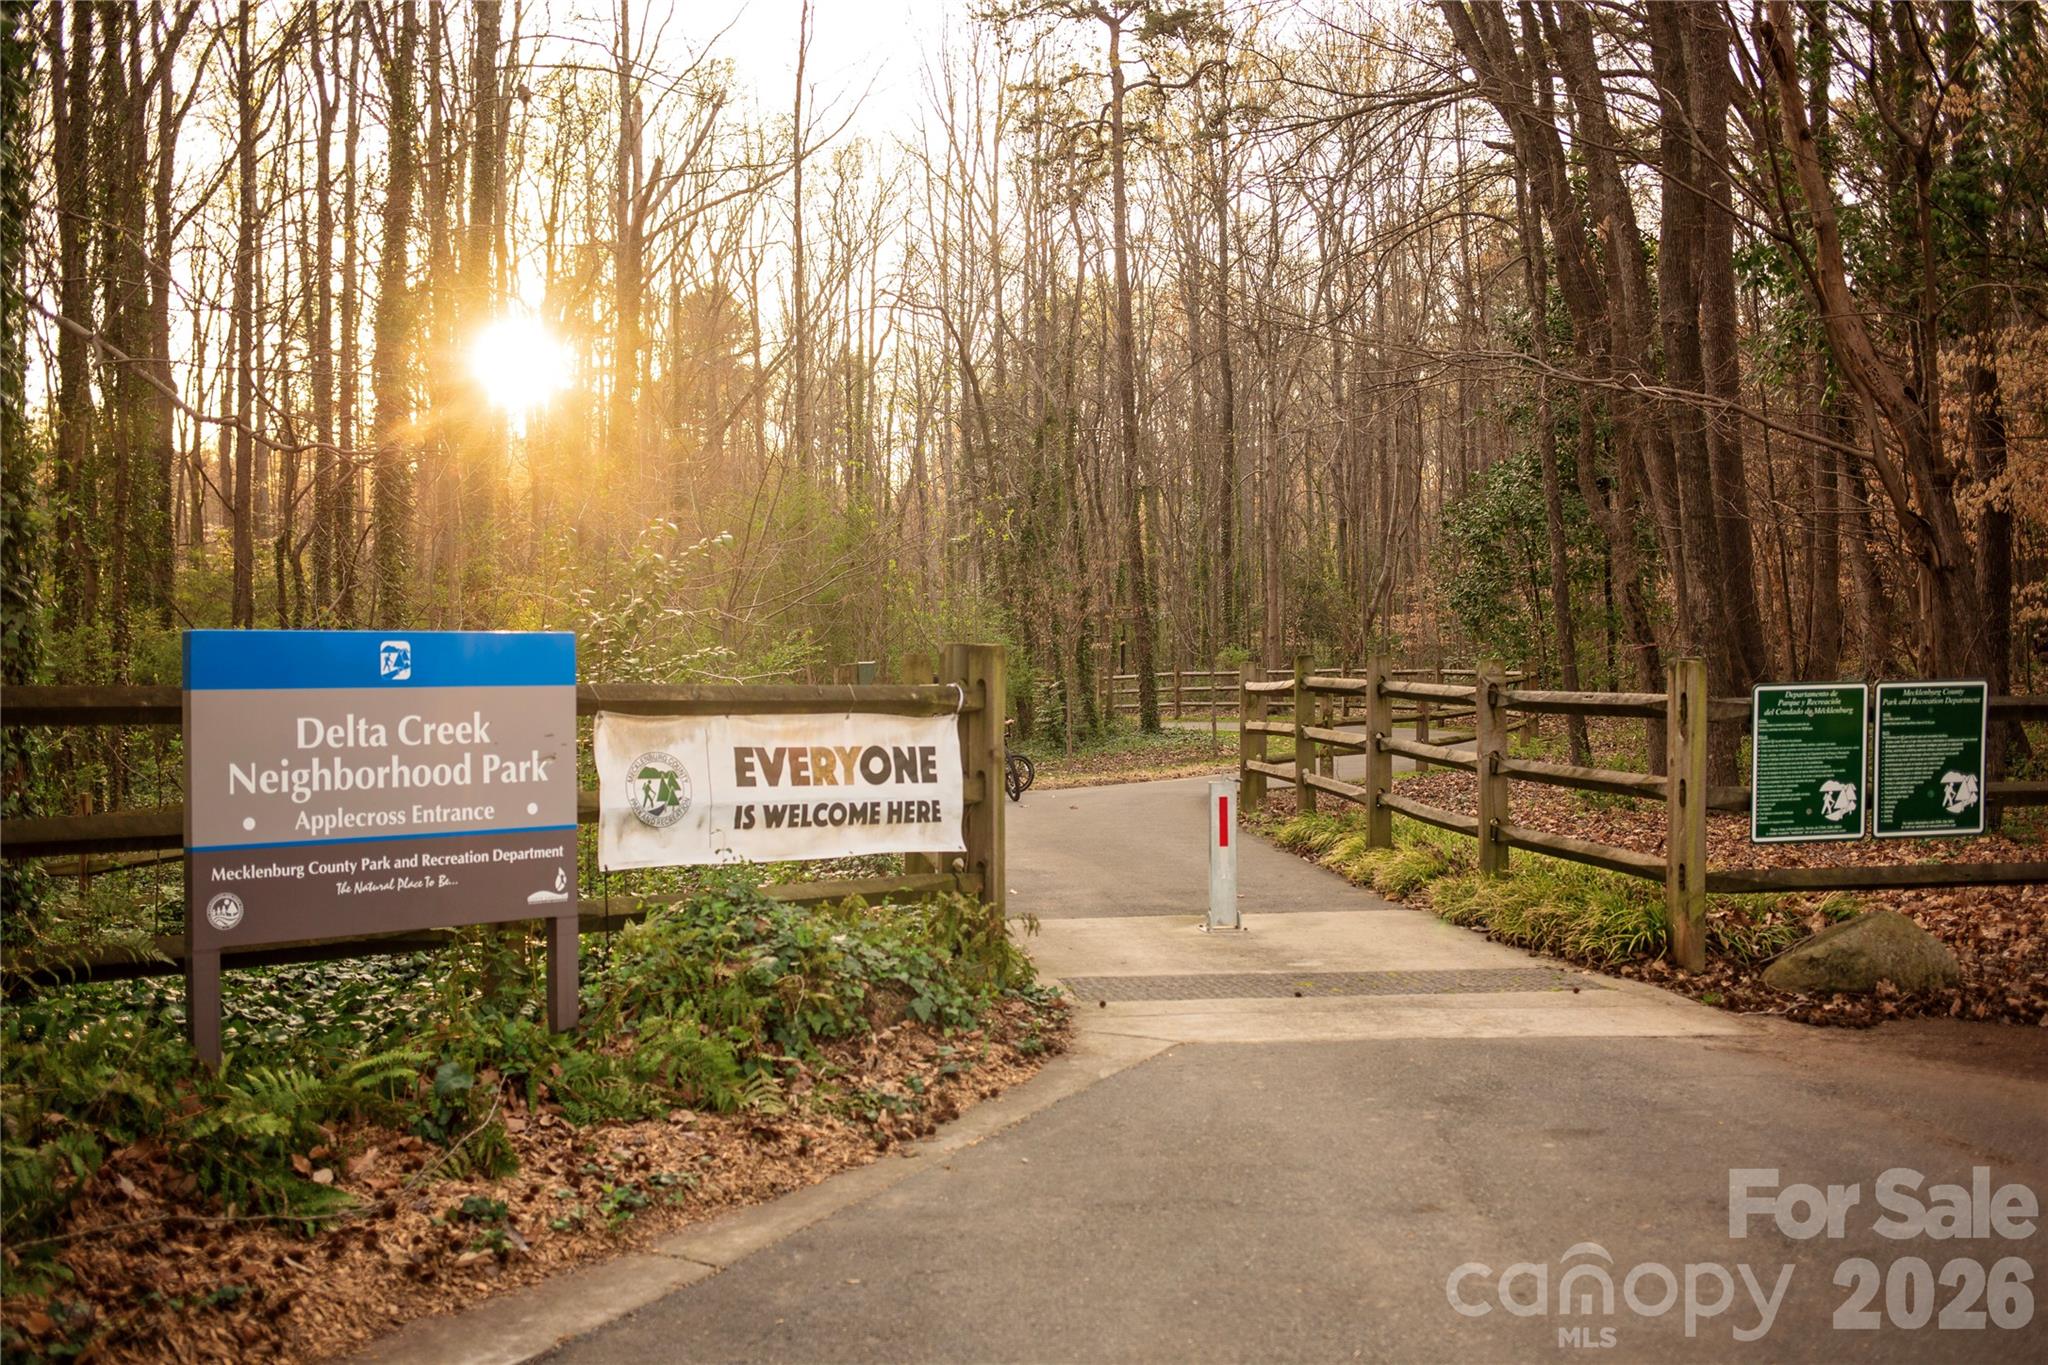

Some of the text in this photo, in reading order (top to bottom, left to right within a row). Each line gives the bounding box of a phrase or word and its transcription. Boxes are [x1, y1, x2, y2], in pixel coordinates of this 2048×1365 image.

[1785, 691, 1828, 699] Departamento
[1899, 697, 1910, 705] and
[1945, 697, 1980, 705] Department
[1943, 688, 1965, 696] County
[297, 712, 490, 749] Delta Creek
[230, 750, 549, 803] Neighborhood Park
[734, 746, 937, 787] EVERYONE
[295, 803, 495, 835] Applecross Entrance
[734, 800, 941, 829] IS WELCOME HERE
[212, 845, 564, 881] Mecklenburg County Park and Recreation Department
[337, 881, 351, 895] The
[354, 878, 395, 894] Natural
[397, 878, 423, 892] Place
[425, 876, 435, 887] To
